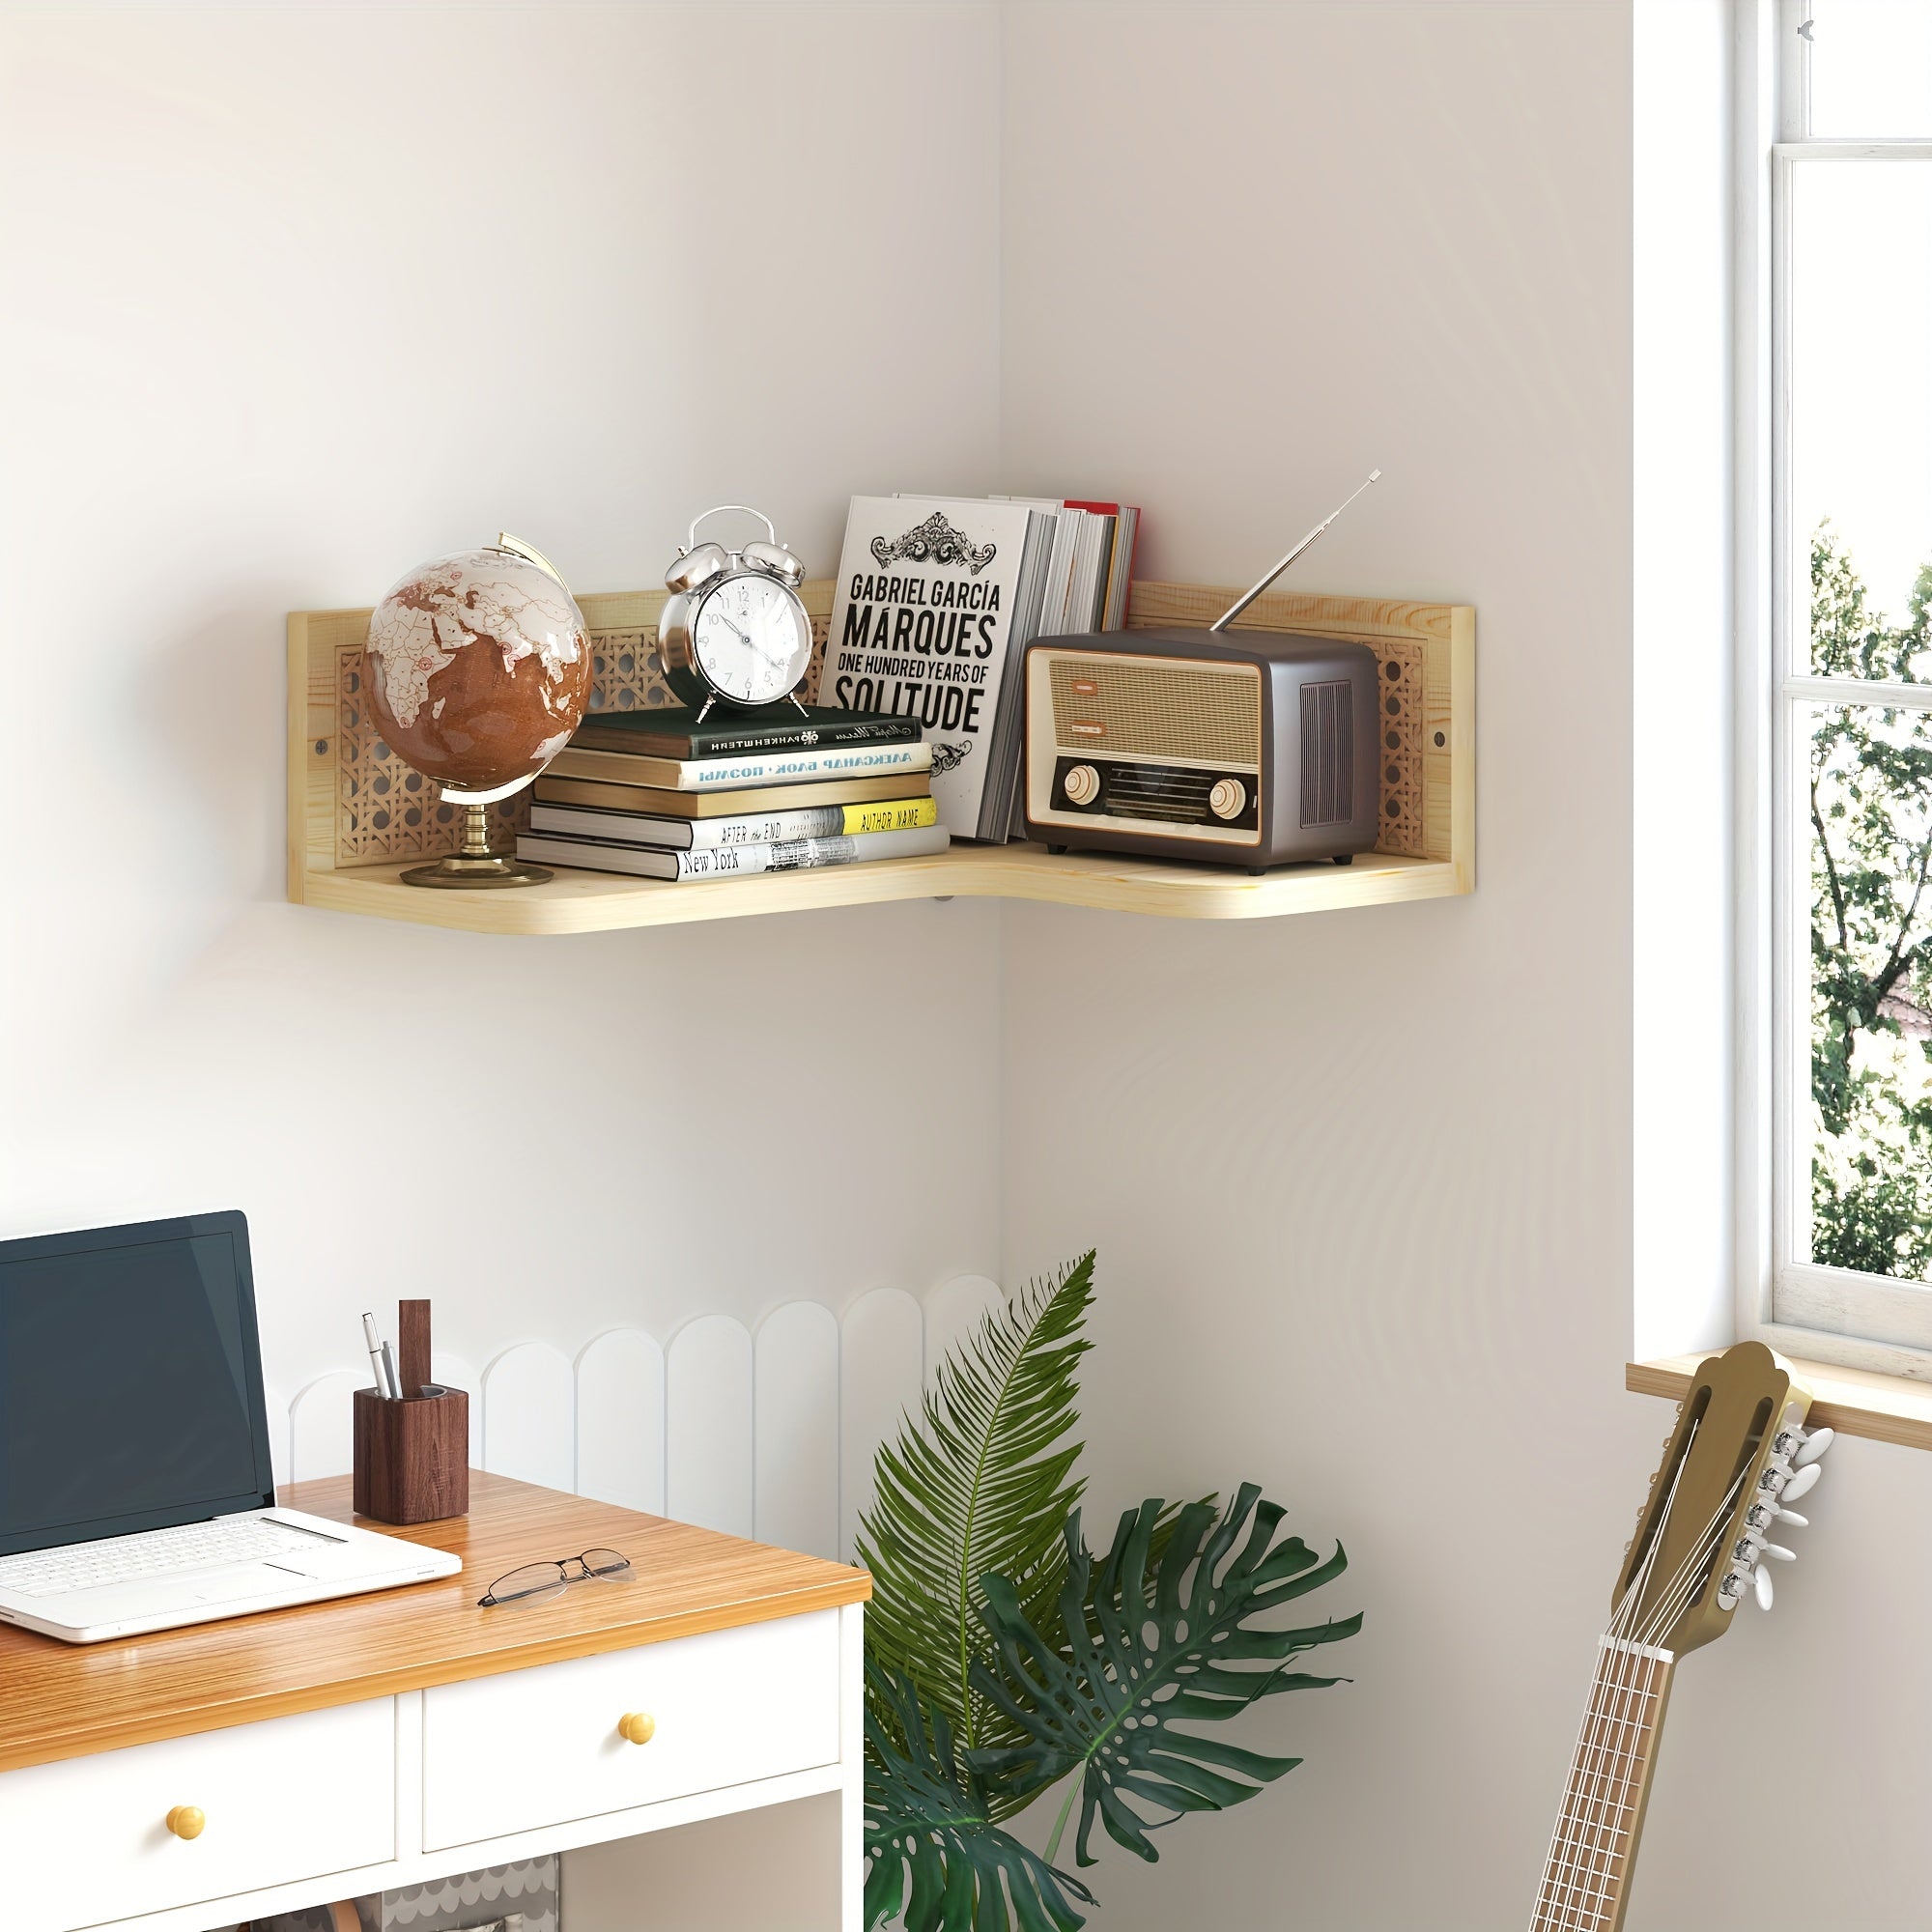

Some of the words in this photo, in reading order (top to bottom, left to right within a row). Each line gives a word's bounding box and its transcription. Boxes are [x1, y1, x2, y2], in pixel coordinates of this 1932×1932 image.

[737, 590, 749, 602] 12
[850, 574, 926, 606] GABRIEL
[930, 581, 1000, 611] GARCÍA
[721, 597, 729, 609] 11
[706, 613, 719, 625] 10
[842, 604, 997, 659] MÁRQUES
[838, 653, 864, 672] ONE
[865, 655, 925, 679] HUNDRED
[927, 661, 969, 683] YEARS
[971, 665, 989, 684] OF
[724, 672, 733, 686] 7
[744, 677, 752, 689] 6
[721, 826, 747, 843] AFTER
[751, 829, 761, 841] the
[764, 822, 781, 839] END
[861, 811, 892, 831] AUTHOR
[897, 809, 919, 827] NAME
[684, 851, 708, 874] New
[711, 847, 738, 870] York
